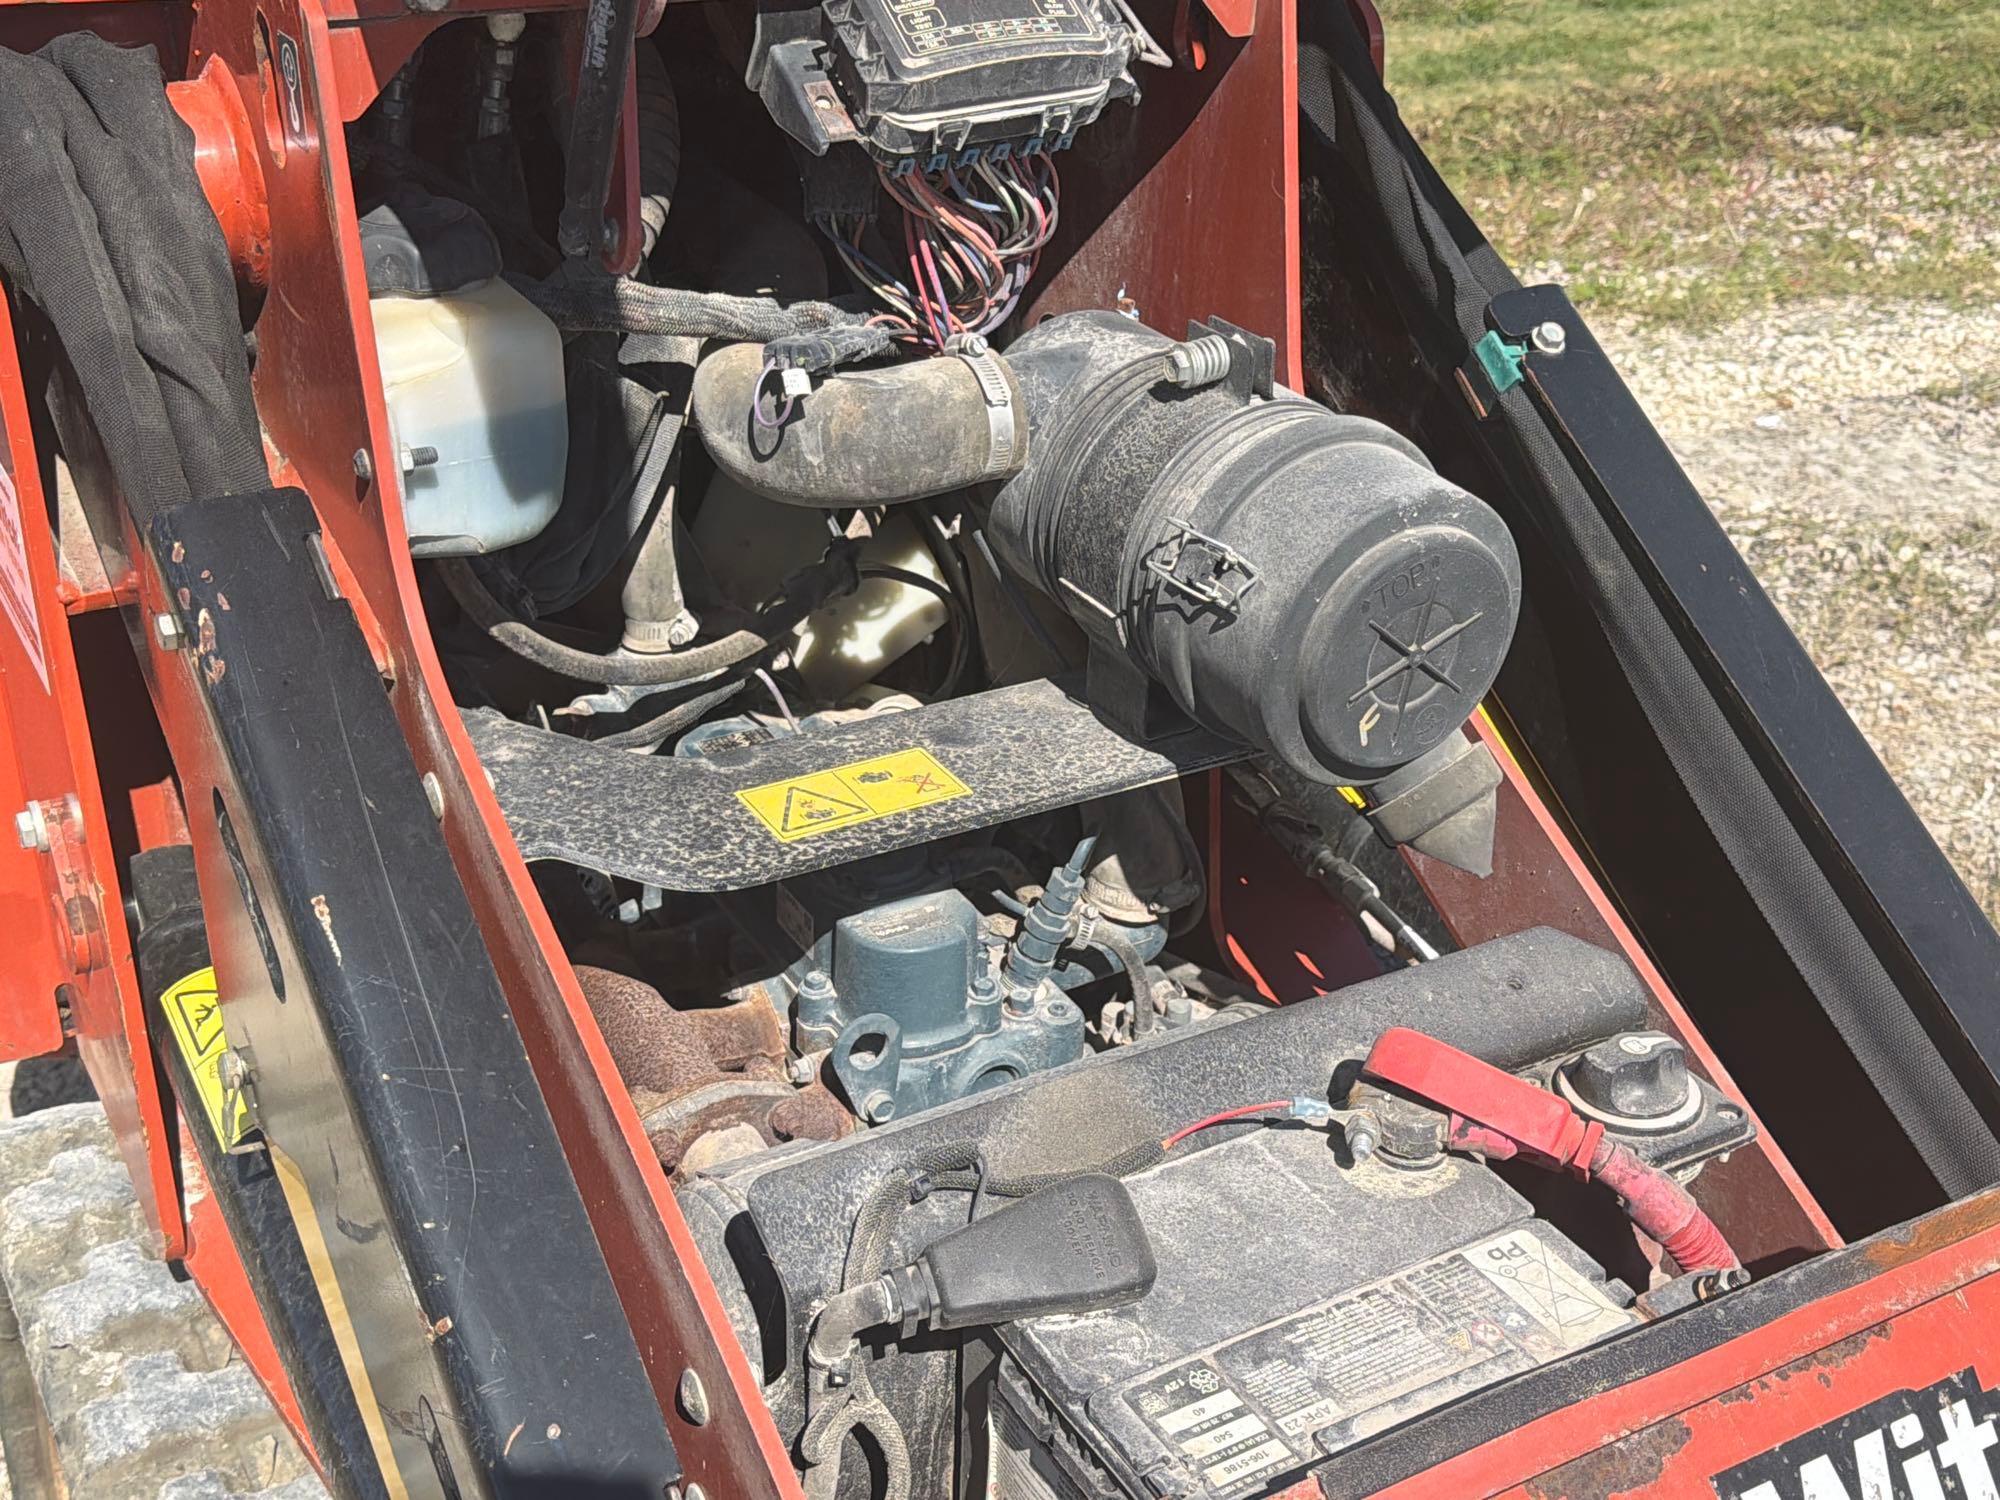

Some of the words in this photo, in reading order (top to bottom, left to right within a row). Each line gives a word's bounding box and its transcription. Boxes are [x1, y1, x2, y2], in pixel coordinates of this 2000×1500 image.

[1373, 561, 1425, 610] TOP
[1082, 1233, 1106, 1280] REMOVE
[1487, 1240, 1528, 1261] Pb
[1164, 1378, 1186, 1394] 12V
[1192, 1407, 1206, 1417] 40
[1301, 1404, 1332, 1423] APR
[1284, 1416, 1302, 1431] 23
[1212, 1430, 1234, 1444] 540
[1223, 1450, 1270, 1476] 106-5186
